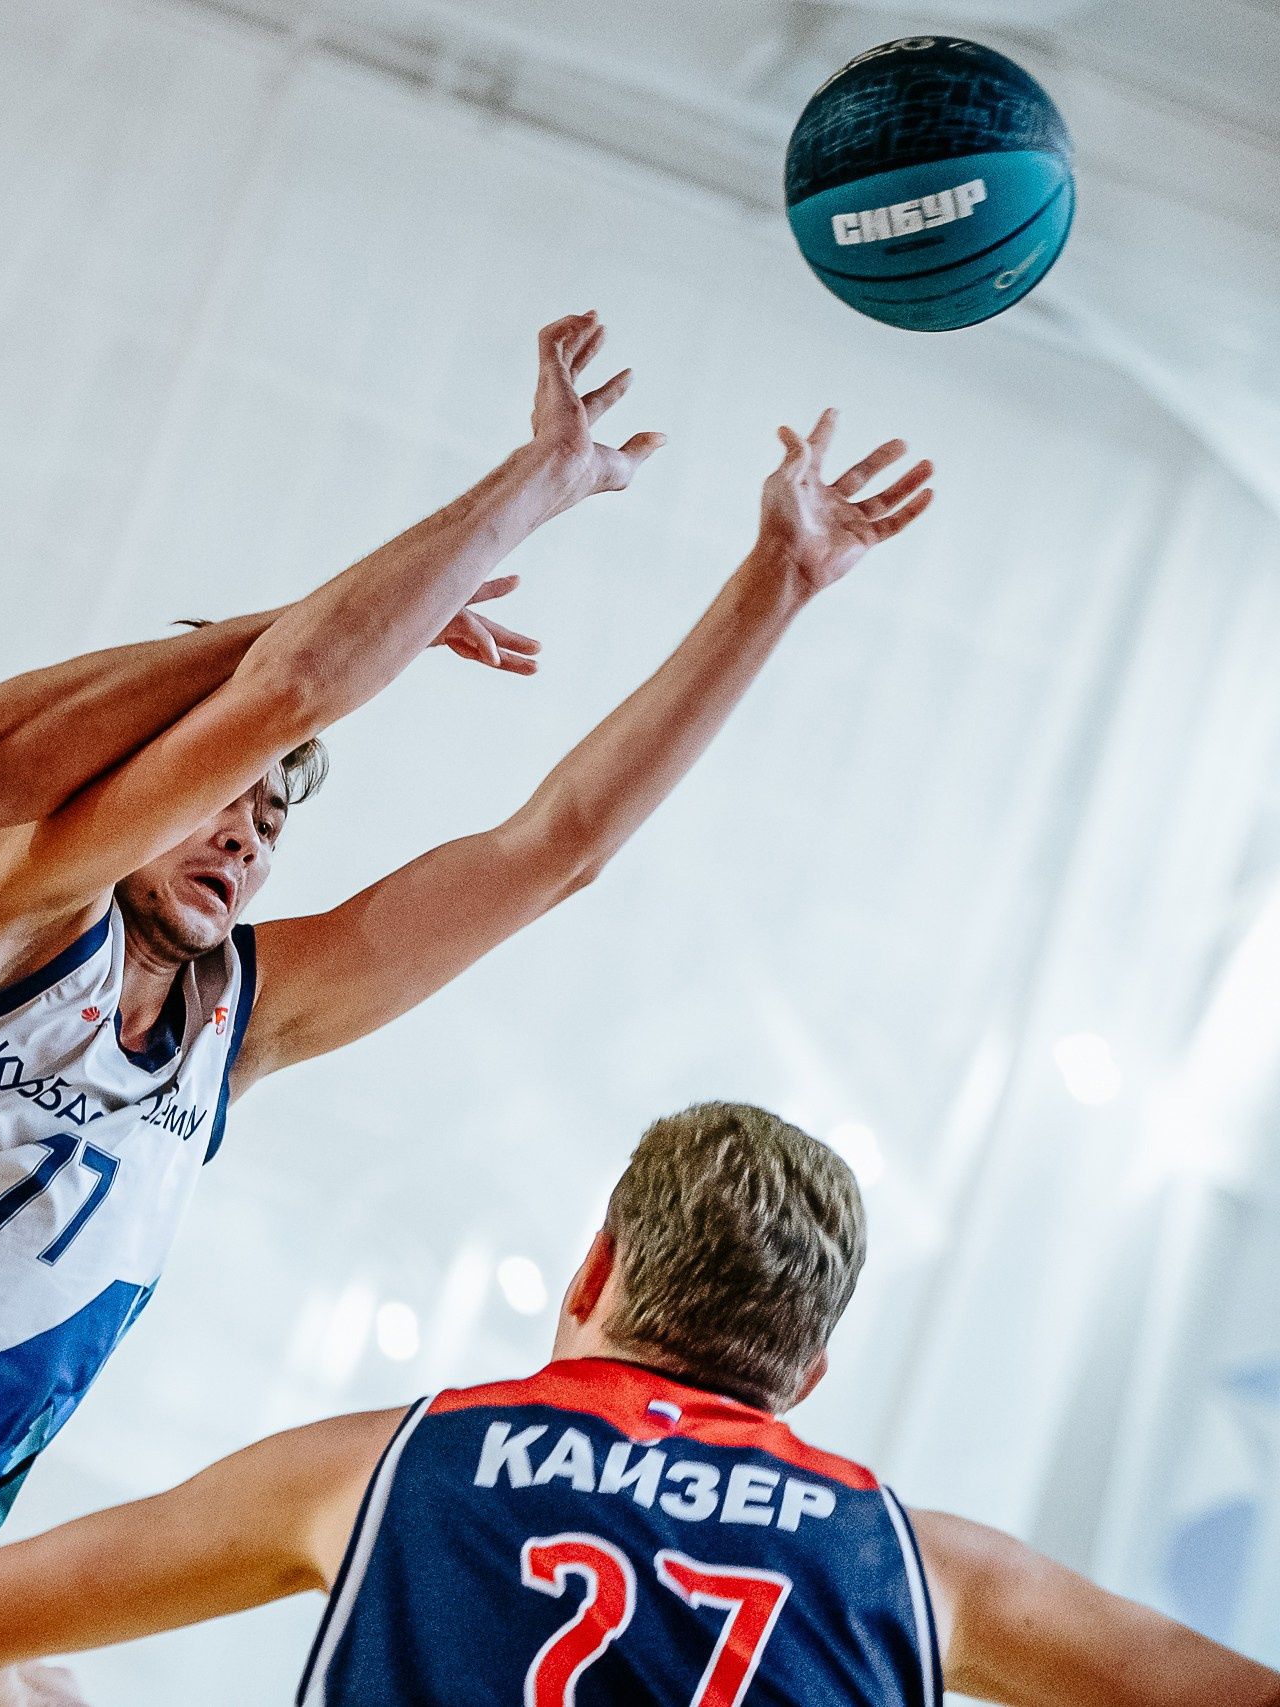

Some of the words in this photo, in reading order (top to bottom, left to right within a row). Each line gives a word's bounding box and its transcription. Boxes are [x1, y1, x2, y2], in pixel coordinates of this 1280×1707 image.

[831, 178, 988, 247] СИБУР
[472, 1421, 837, 1533] КАЙЗЕР
[521, 1531, 793, 1707] 27
